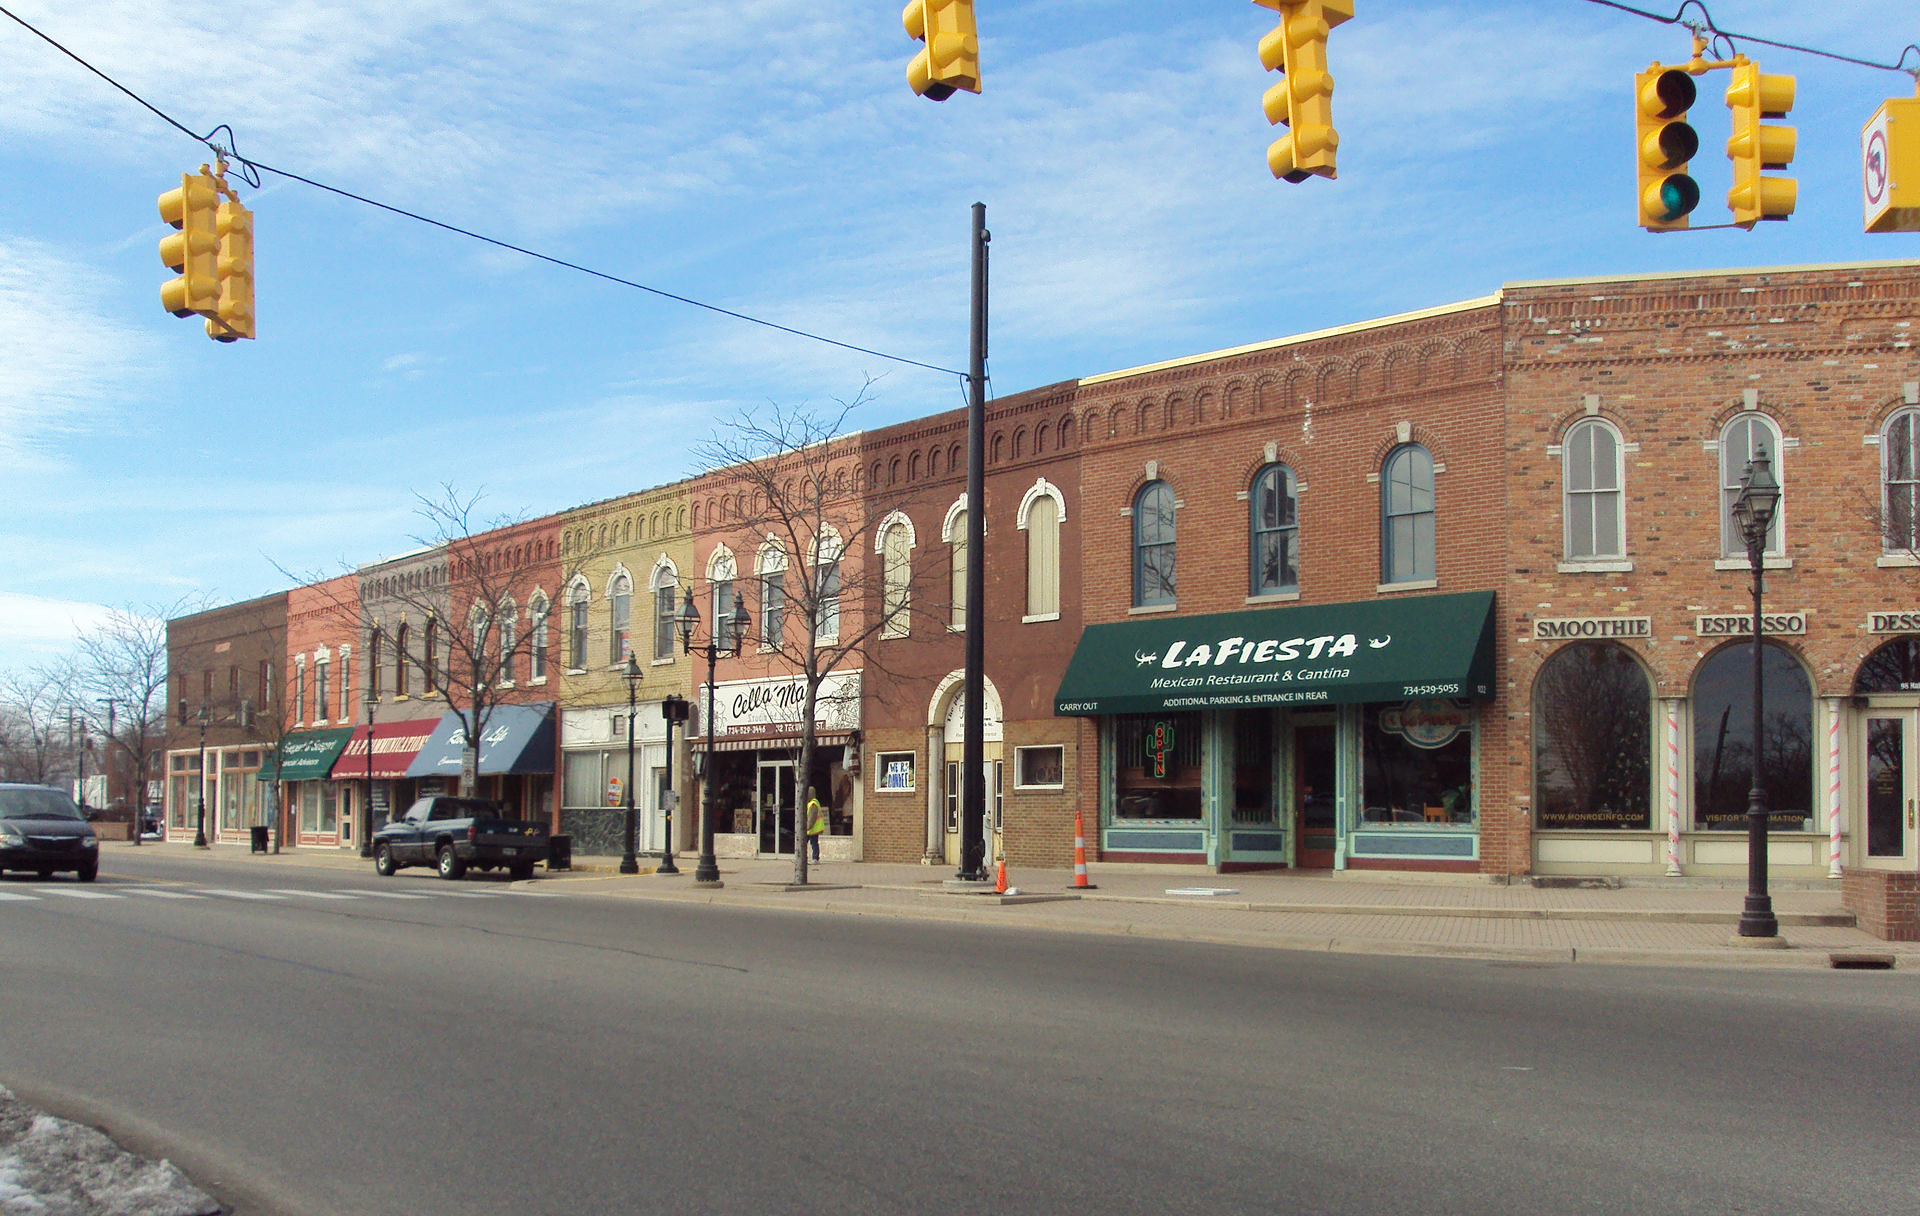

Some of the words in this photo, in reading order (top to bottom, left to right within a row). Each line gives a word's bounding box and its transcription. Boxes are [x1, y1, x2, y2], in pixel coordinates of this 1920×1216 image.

[1537, 619, 1648, 637] SMOOTHIE
[1700, 616, 1802, 634] ESPRSSO
[1150, 676, 1203, 689] Mexican
[1206, 672, 1279, 686] Restaurant
[1282, 670, 1293, 681] &
[1297, 667, 1350, 681] Cantina
[1403, 683, 1459, 695] 734-529-5055
[1060, 703, 1082, 711] CARRY
[1082, 702, 1098, 710] OUT
[1163, 697, 1208, 707] ADDITIONAL
[1210, 695, 1244, 705] PARKING
[1244, 695, 1251, 703] &
[1252, 693, 1294, 703] ENTRANCE
[1295, 692, 1304, 701] IN
[1306, 691, 1328, 700] REAR
[1156, 727, 1164, 775] OPEN
[1542, 813, 1644, 821] WWW.MONROEINFO.COM
[1705, 814, 1739, 822] VISITOR
